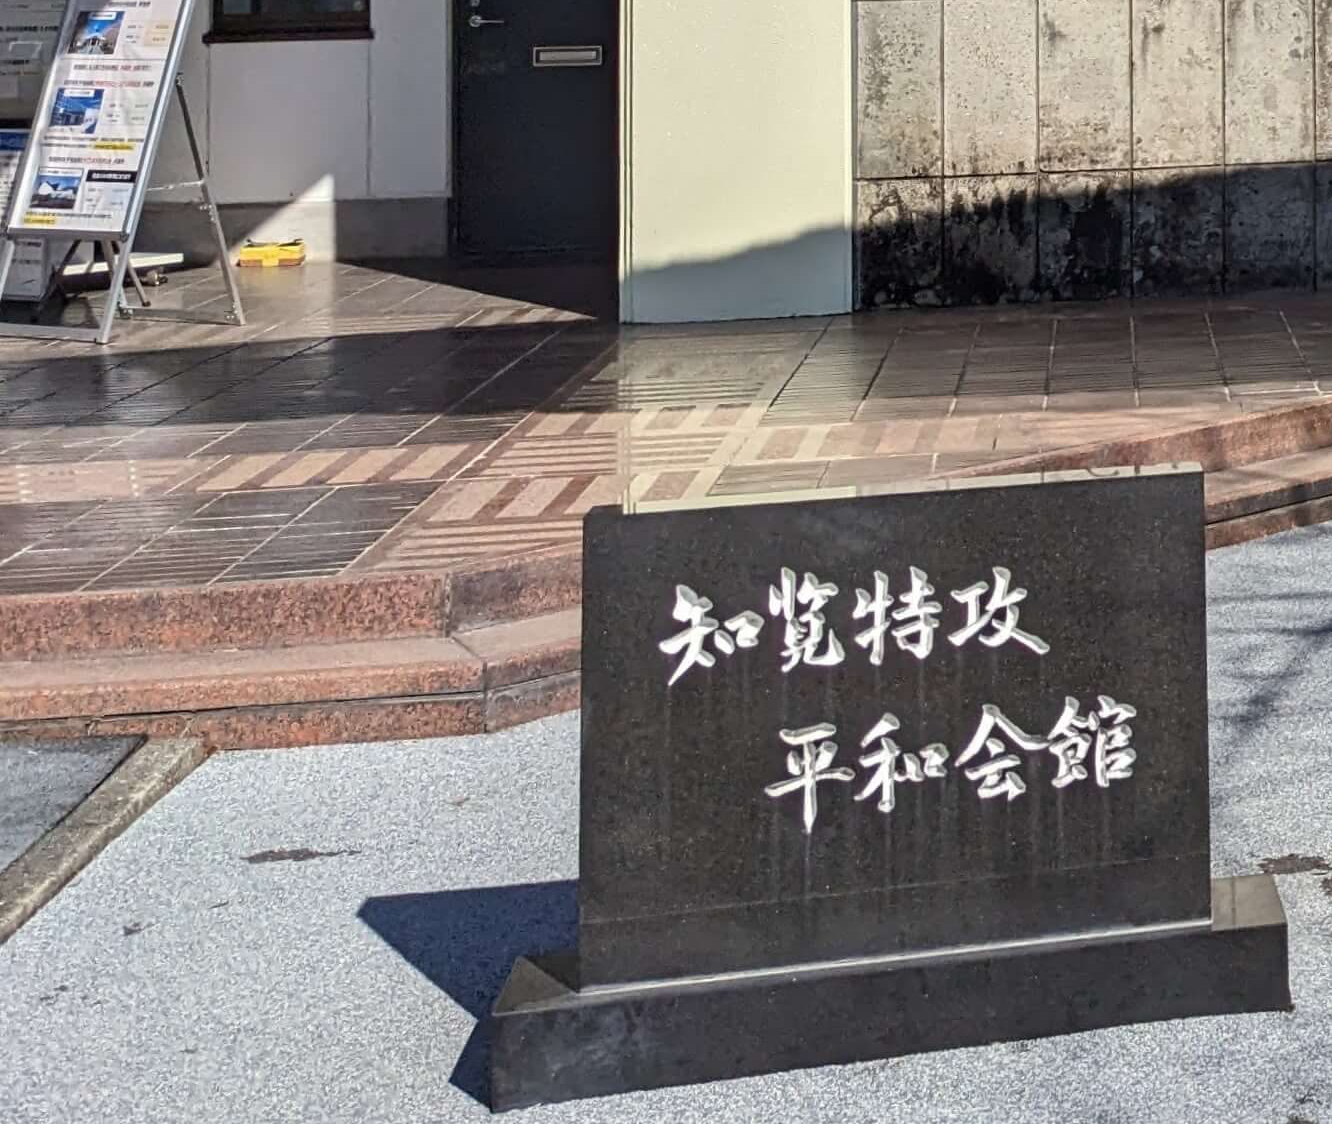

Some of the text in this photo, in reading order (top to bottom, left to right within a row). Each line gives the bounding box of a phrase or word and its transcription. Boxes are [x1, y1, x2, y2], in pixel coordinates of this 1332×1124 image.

[658, 567, 1050, 687] 知覧特攻
[764, 695, 1137, 833] 平和会館
